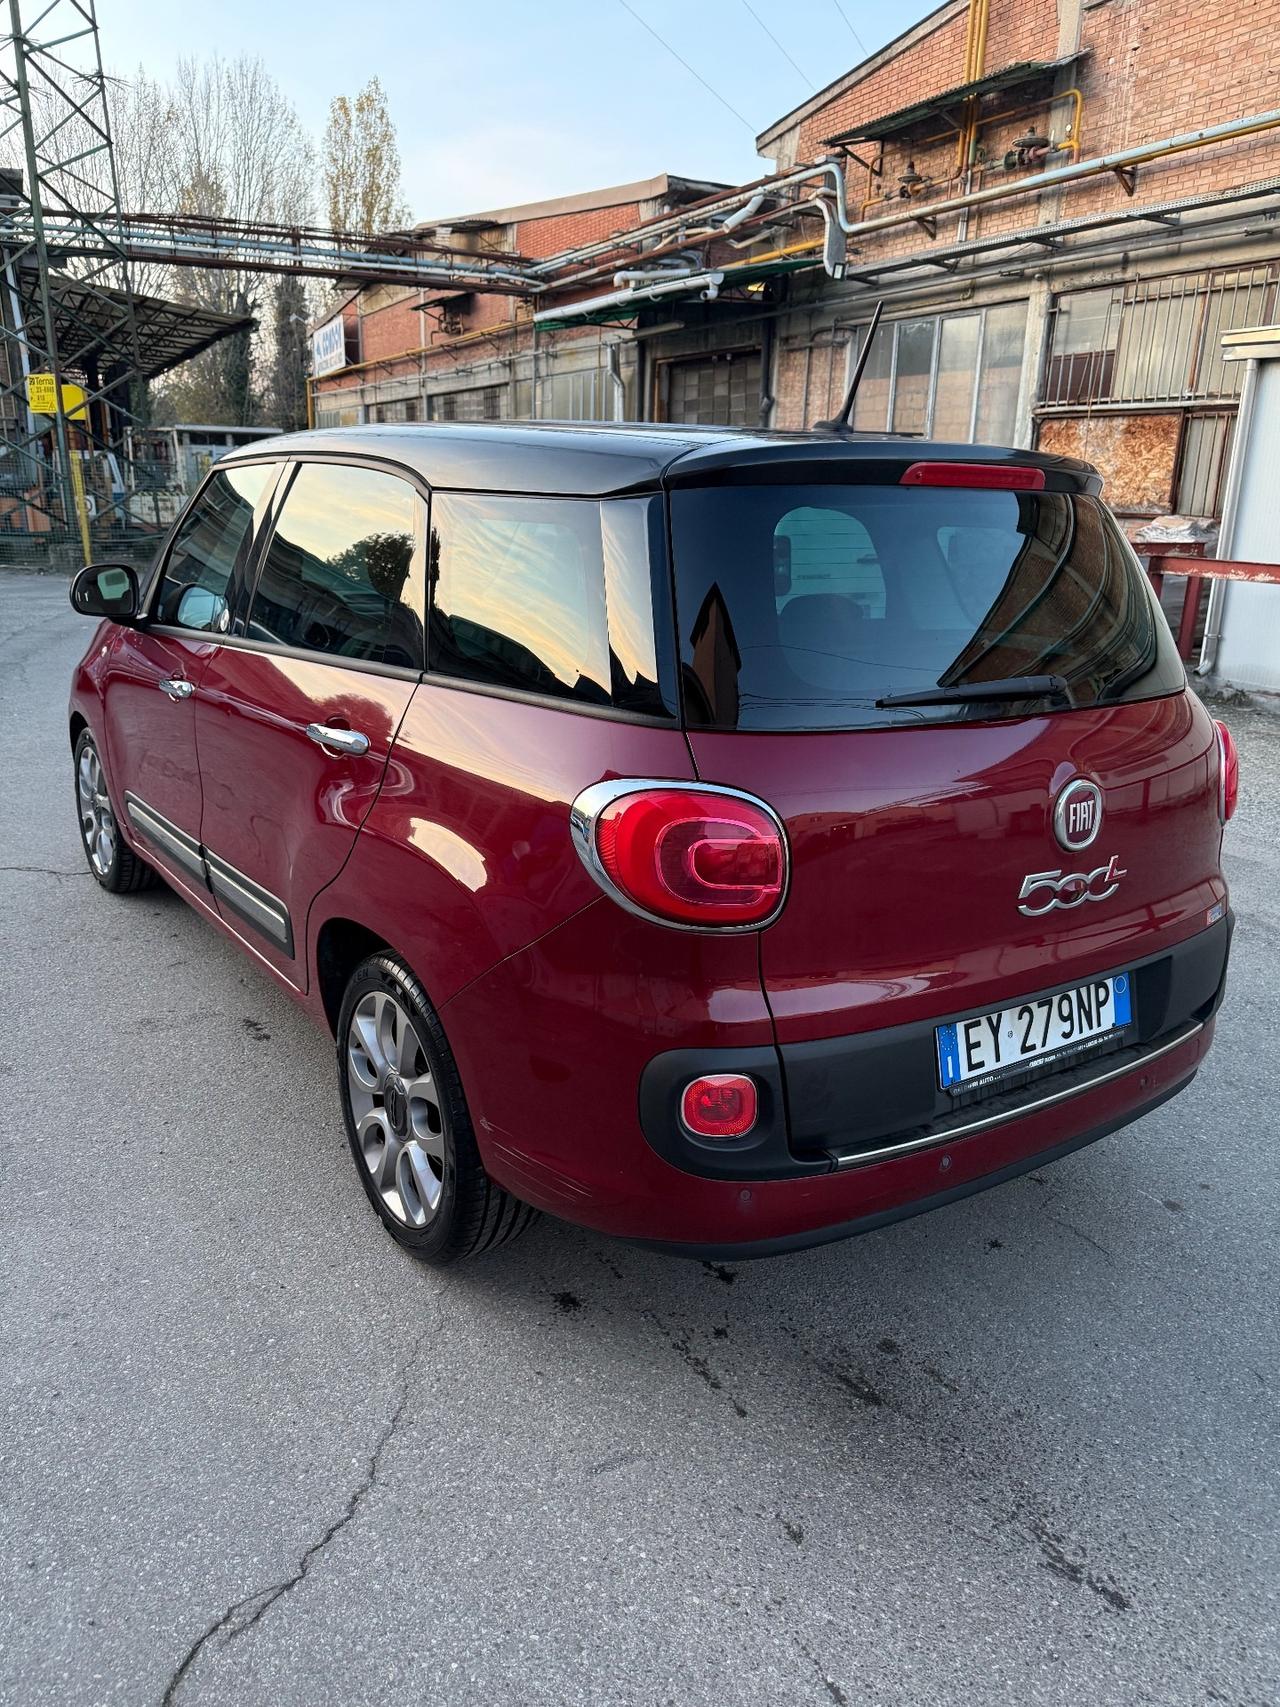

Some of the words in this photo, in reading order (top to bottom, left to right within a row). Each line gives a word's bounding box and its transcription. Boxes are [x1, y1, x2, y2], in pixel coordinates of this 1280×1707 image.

[1069, 800, 1095, 834] FIAT
[964, 1012, 1003, 1072] EY
[1018, 981, 1110, 1055] 279NP
